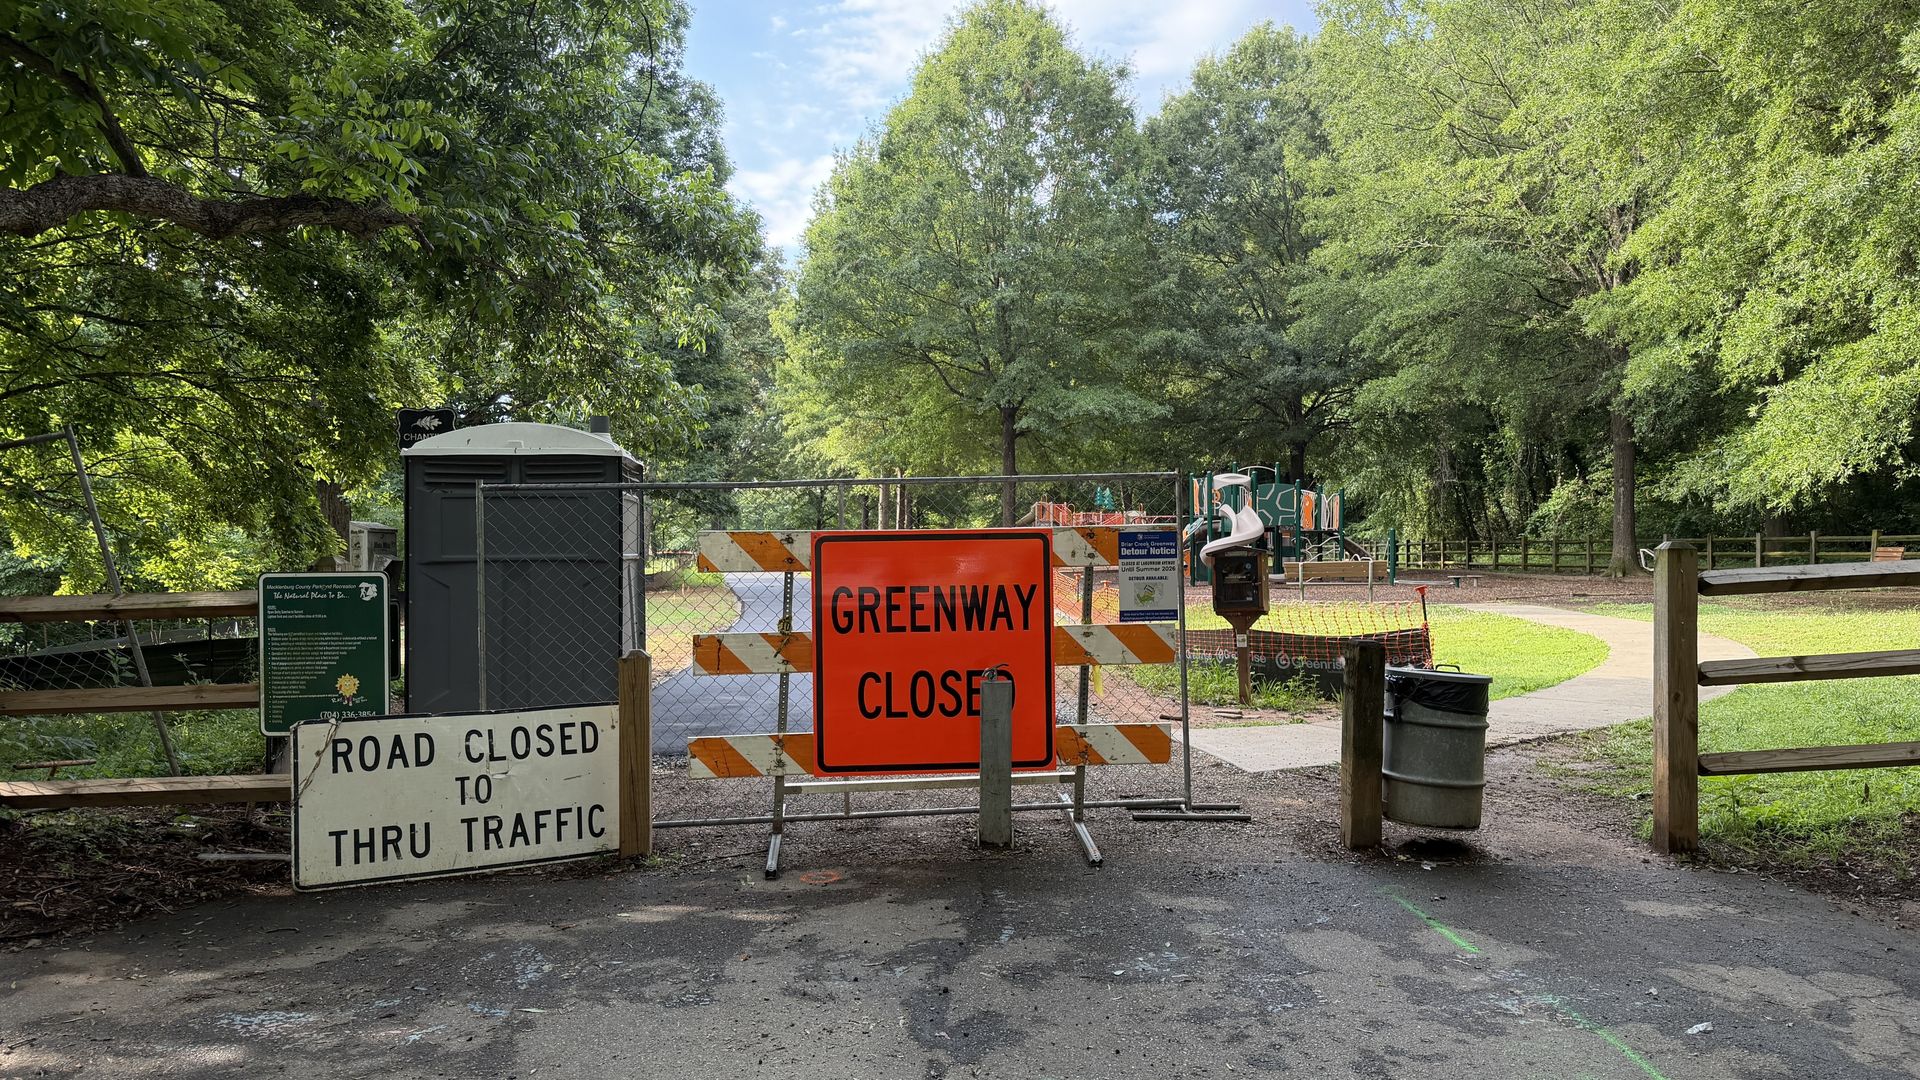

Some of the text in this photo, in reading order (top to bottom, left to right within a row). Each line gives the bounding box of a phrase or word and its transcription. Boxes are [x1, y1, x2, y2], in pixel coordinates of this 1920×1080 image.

[831, 583, 1038, 635] GREENWAY
[319, 711, 340, 720] (704)
[857, 669, 1016, 720] CLOSE
[331, 721, 599, 774] ROAD CLOSED
[455, 774, 492, 806] TO
[328, 804, 606, 867] THRU TRAFFIC
